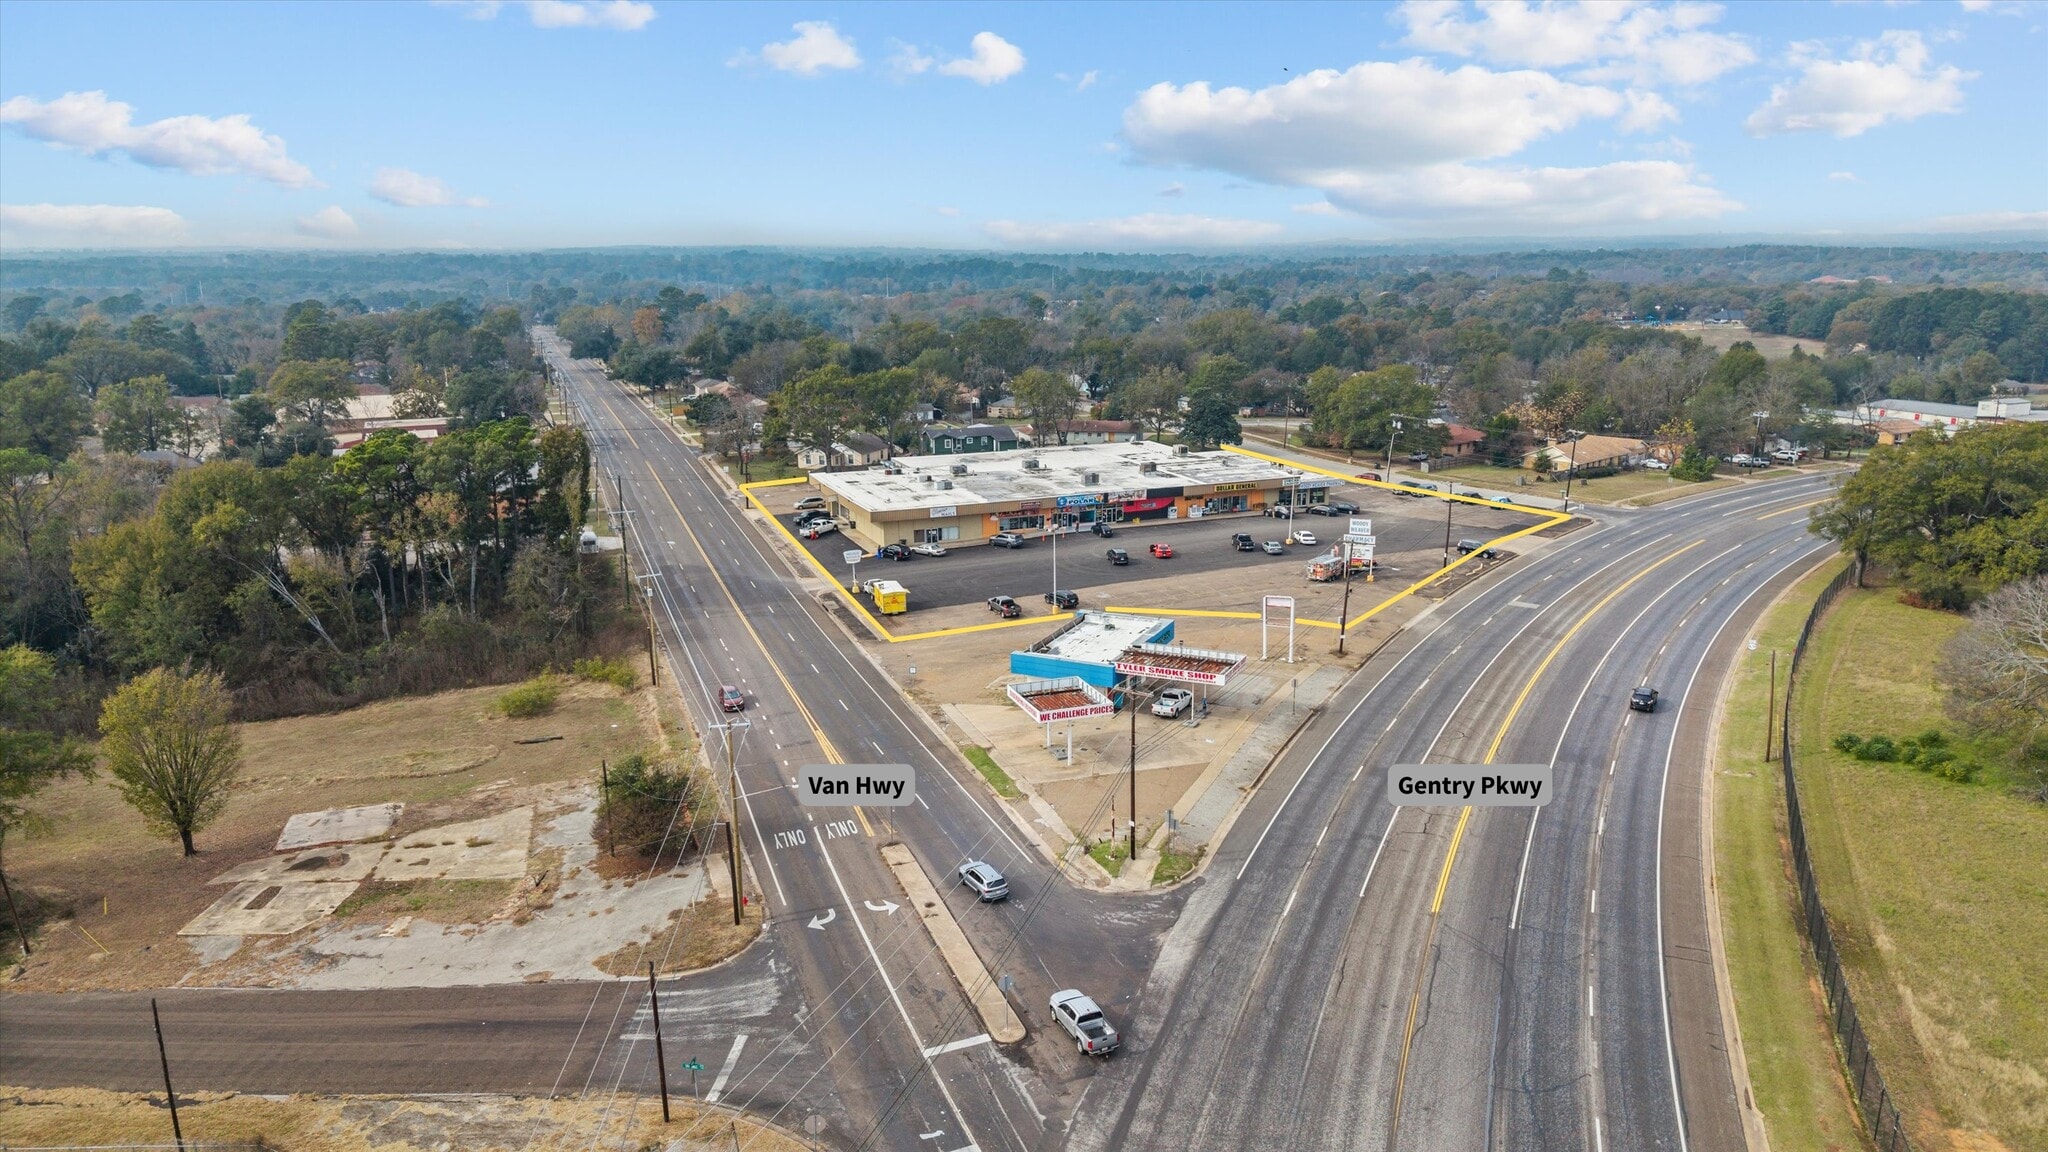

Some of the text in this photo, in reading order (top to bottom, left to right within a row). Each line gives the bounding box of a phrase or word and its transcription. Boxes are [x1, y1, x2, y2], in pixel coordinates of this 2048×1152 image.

[1236, 482, 1257, 490] GENERAL
[1115, 662, 1146, 672] TYLER
[1148, 666, 1184, 677] SMOKE
[1187, 671, 1217, 680] SHOP
[1040, 704, 1114, 722] WE CHALLENGE PRICES
[825, 819, 858, 840] ONLY
[774, 829, 806, 850] ONLY
